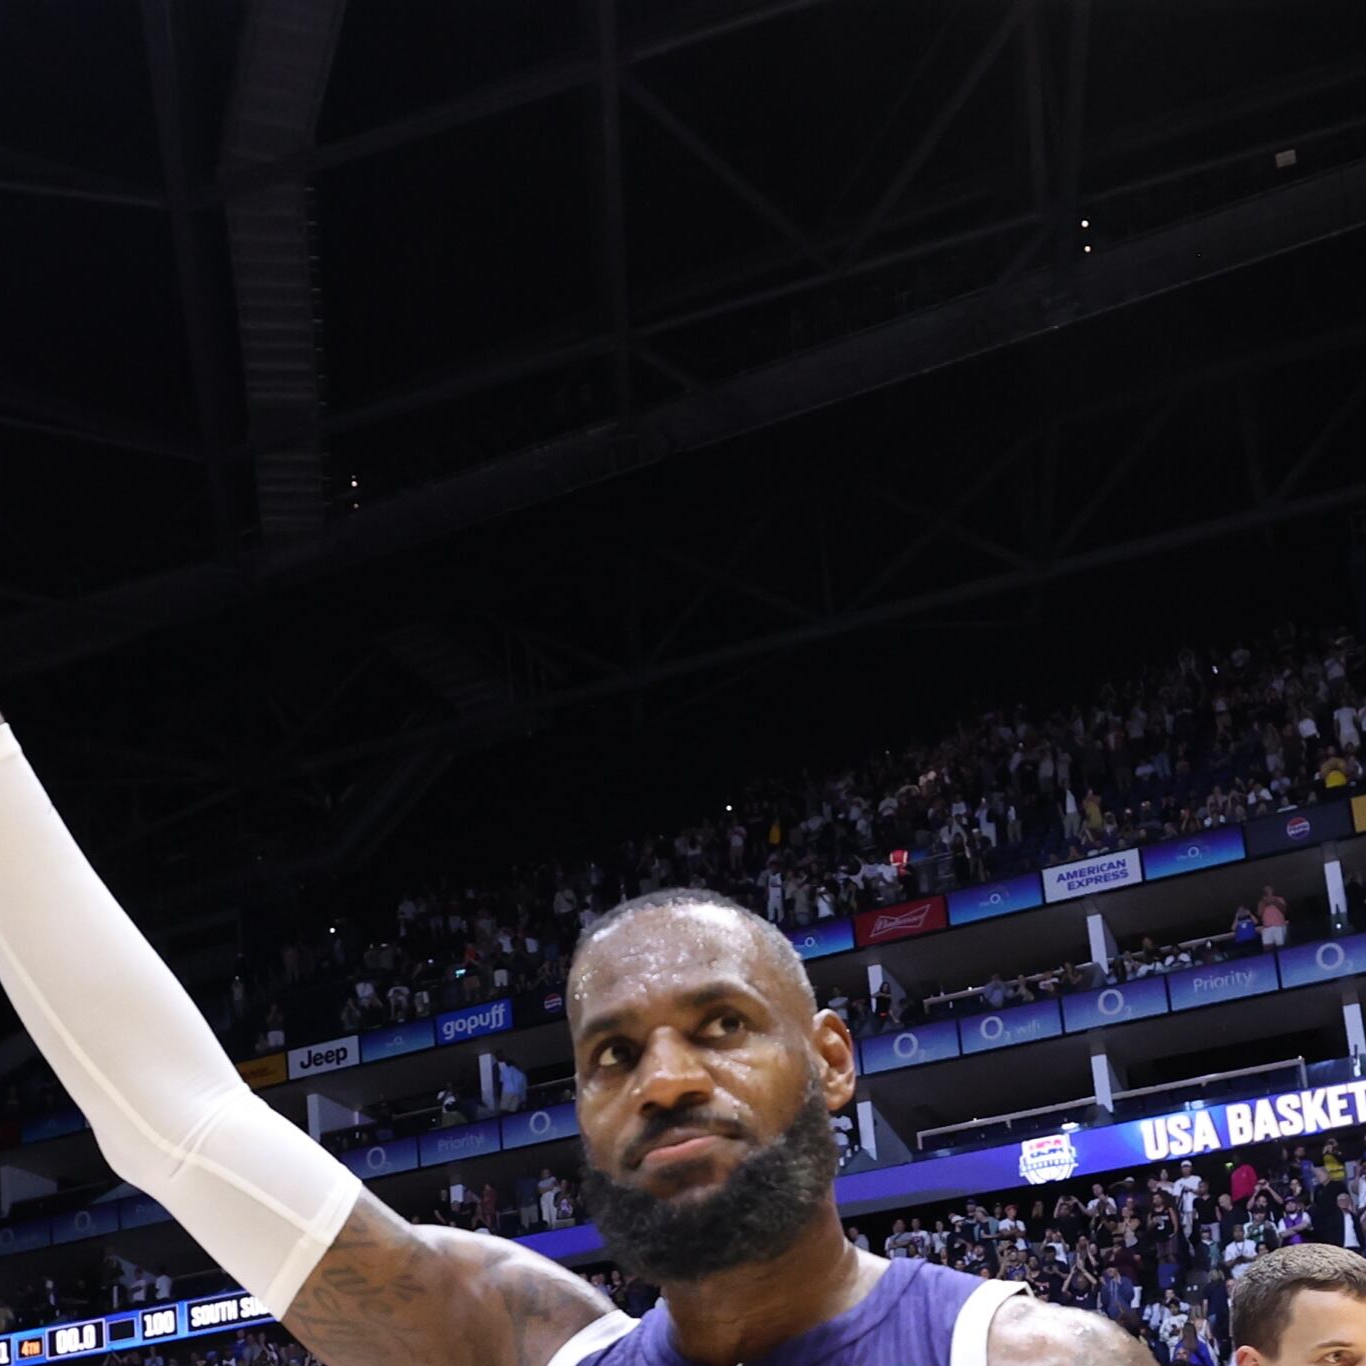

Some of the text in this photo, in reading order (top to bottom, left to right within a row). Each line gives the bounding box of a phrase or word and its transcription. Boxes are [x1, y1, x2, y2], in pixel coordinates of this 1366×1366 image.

[1056, 858, 1127, 884] AMERICAN
[1067, 869, 1129, 891] EXPRESS
[1193, 968, 1252, 995] Priority
[442, 1004, 506, 1041] gopuff
[299, 1045, 348, 1070] Jeep
[1141, 1114, 1222, 1161] USA
[143, 1310, 175, 1337] 100
[191, 1299, 238, 1328] SOUTH
[55, 1324, 96, 1355] 00.0
